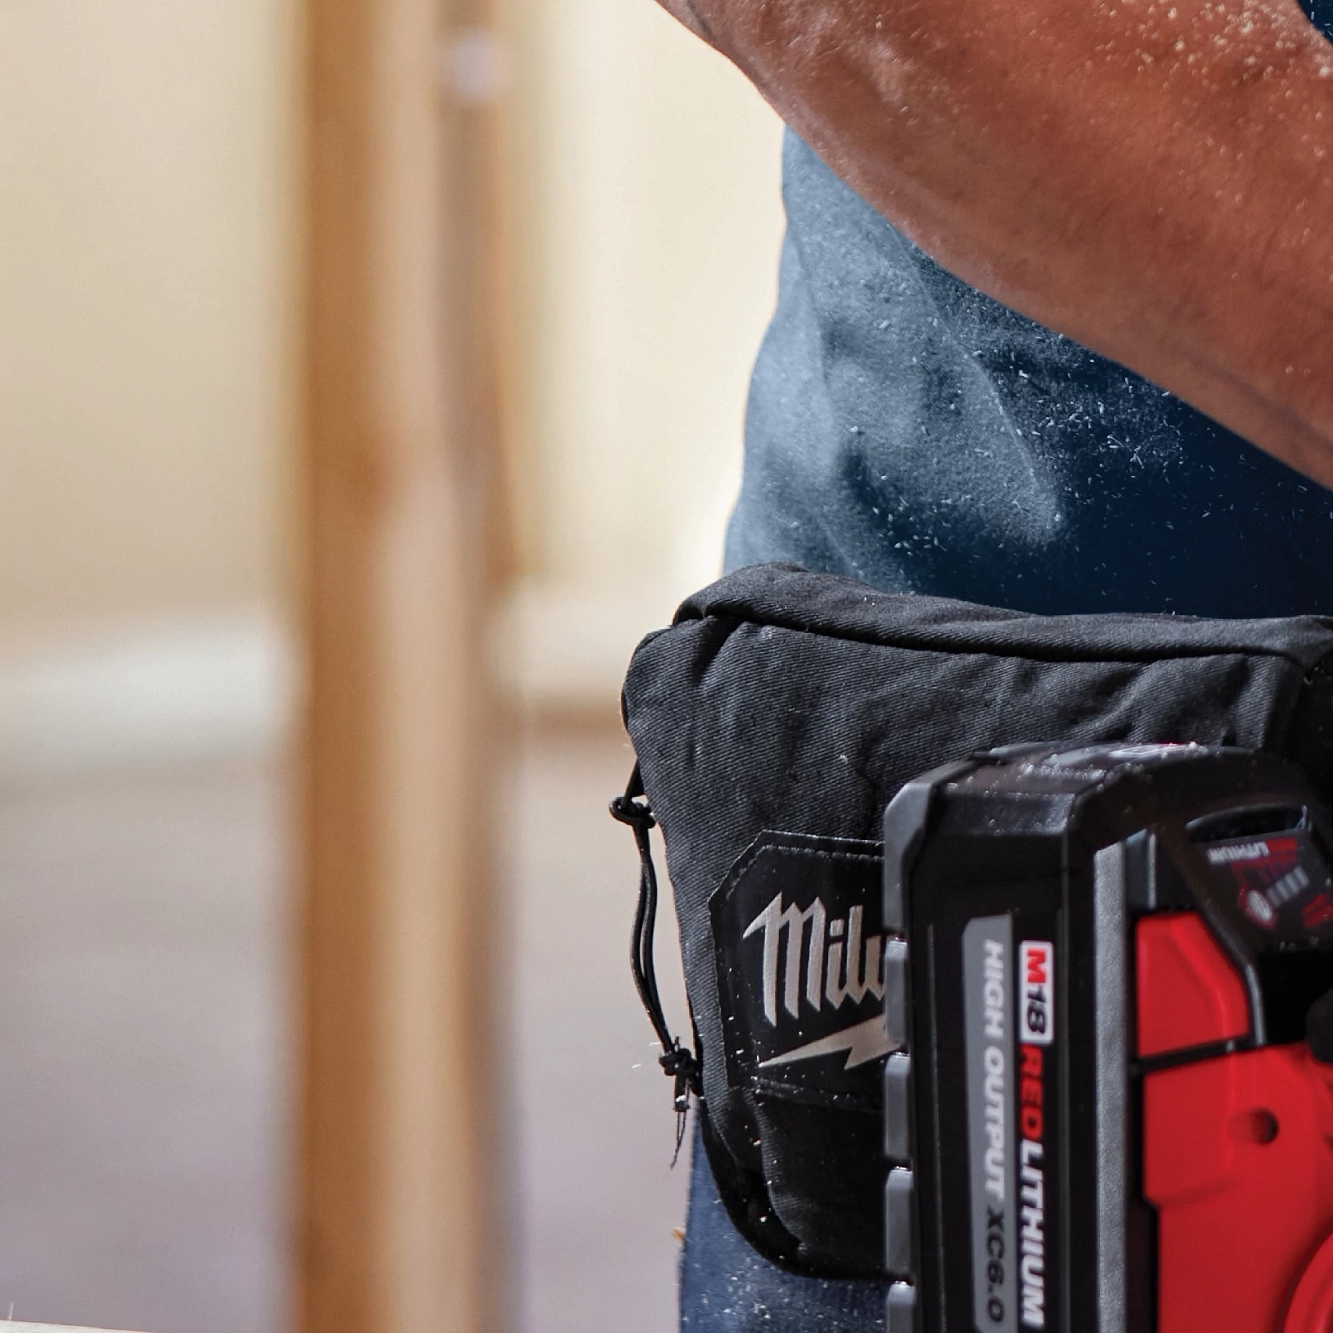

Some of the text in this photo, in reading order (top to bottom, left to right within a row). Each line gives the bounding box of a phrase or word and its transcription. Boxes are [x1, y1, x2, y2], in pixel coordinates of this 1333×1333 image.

[984, 938, 1005, 1039] HIGH
[1025, 946, 1050, 1036] M18
[984, 1044, 1006, 1201] OUTPUT
